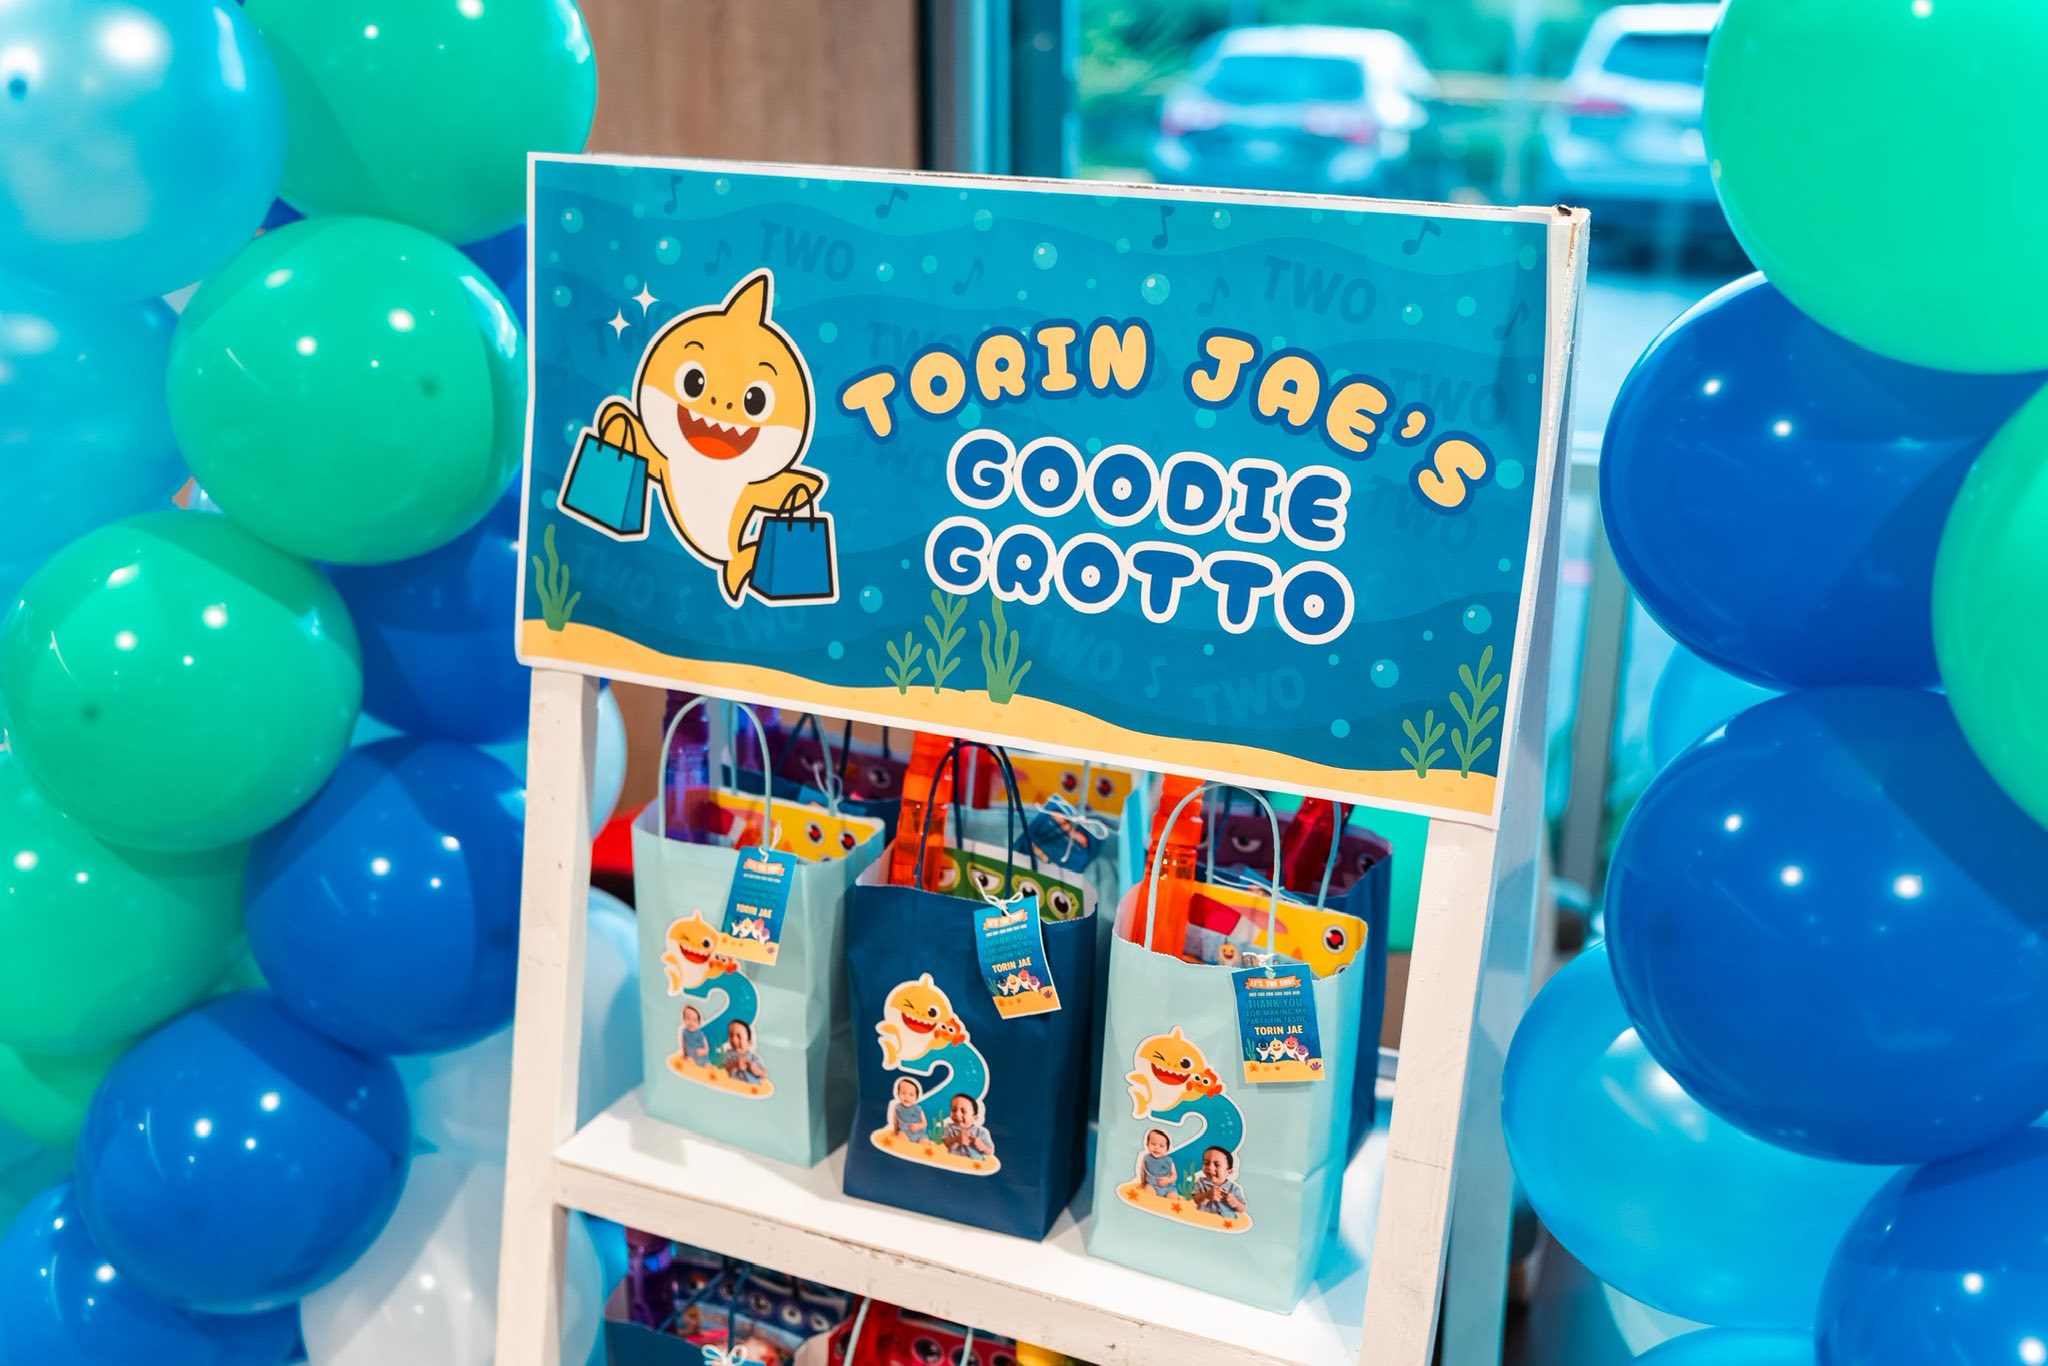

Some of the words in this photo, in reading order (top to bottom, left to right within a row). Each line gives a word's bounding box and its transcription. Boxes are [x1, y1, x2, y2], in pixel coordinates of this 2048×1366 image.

[760, 219, 855, 281] TWO
[1264, 255, 1377, 325] TWO
[837, 317, 1153, 443] TORIN
[1184, 329, 1495, 515] JAE'S
[947, 429, 1351, 551] GOODIE
[925, 516, 1355, 645] GROTTO
[1192, 665, 1305, 726] TWO
[1254, 1026, 1284, 1036] TORIN
[1286, 1025, 1304, 1035] JAE
